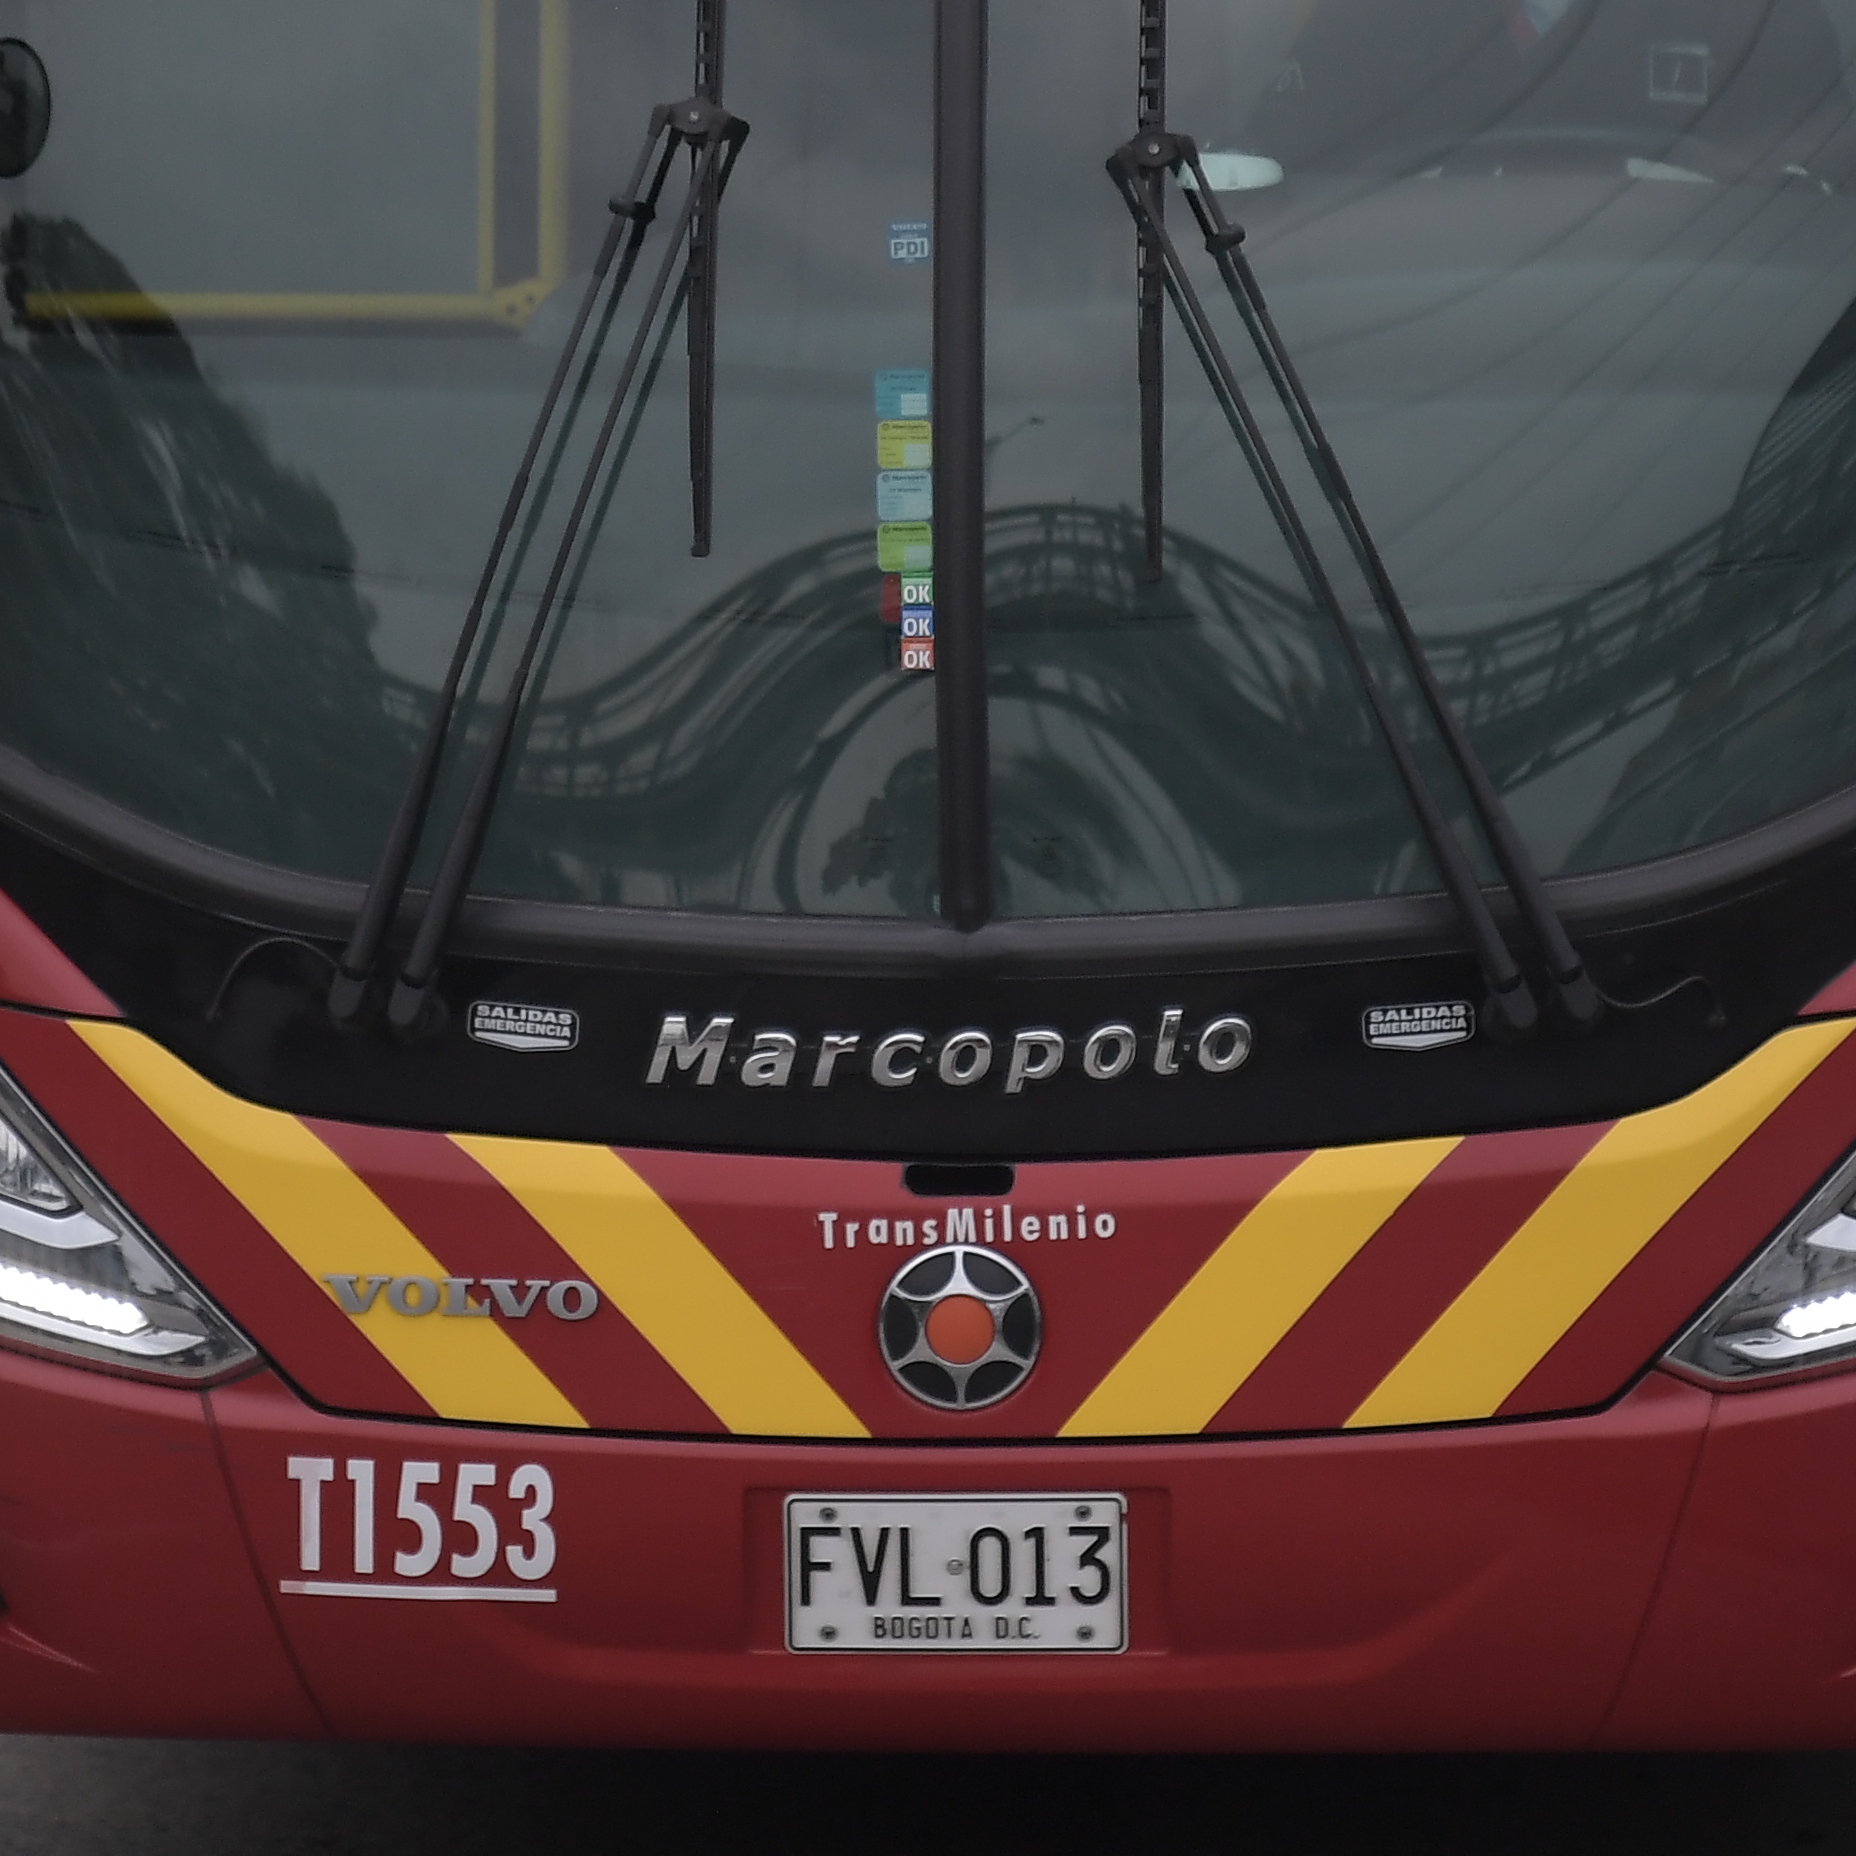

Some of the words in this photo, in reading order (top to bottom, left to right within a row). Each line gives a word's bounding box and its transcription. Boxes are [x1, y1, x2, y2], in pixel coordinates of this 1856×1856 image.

[893, 240, 926, 257] PDI
[903, 585, 931, 604] OK
[903, 618, 931, 637] OK
[903, 650, 932, 670] OK
[476, 1004, 573, 1025] SALIDAS
[1369, 1004, 1466, 1023] SALIDAS
[474, 1017, 572, 1039] EMERGENCIA
[1368, 1017, 1467, 1036] EMERGENCIA
[643, 1005, 1254, 1094] Marcopolo
[816, 1204, 1117, 1250] TransMilenio
[321, 1274, 600, 1322] VOLVO
[286, 1456, 557, 1582] T1553
[873, 1615, 974, 1640] BOGOTA
[994, 1615, 1042, 1640] D.C.
